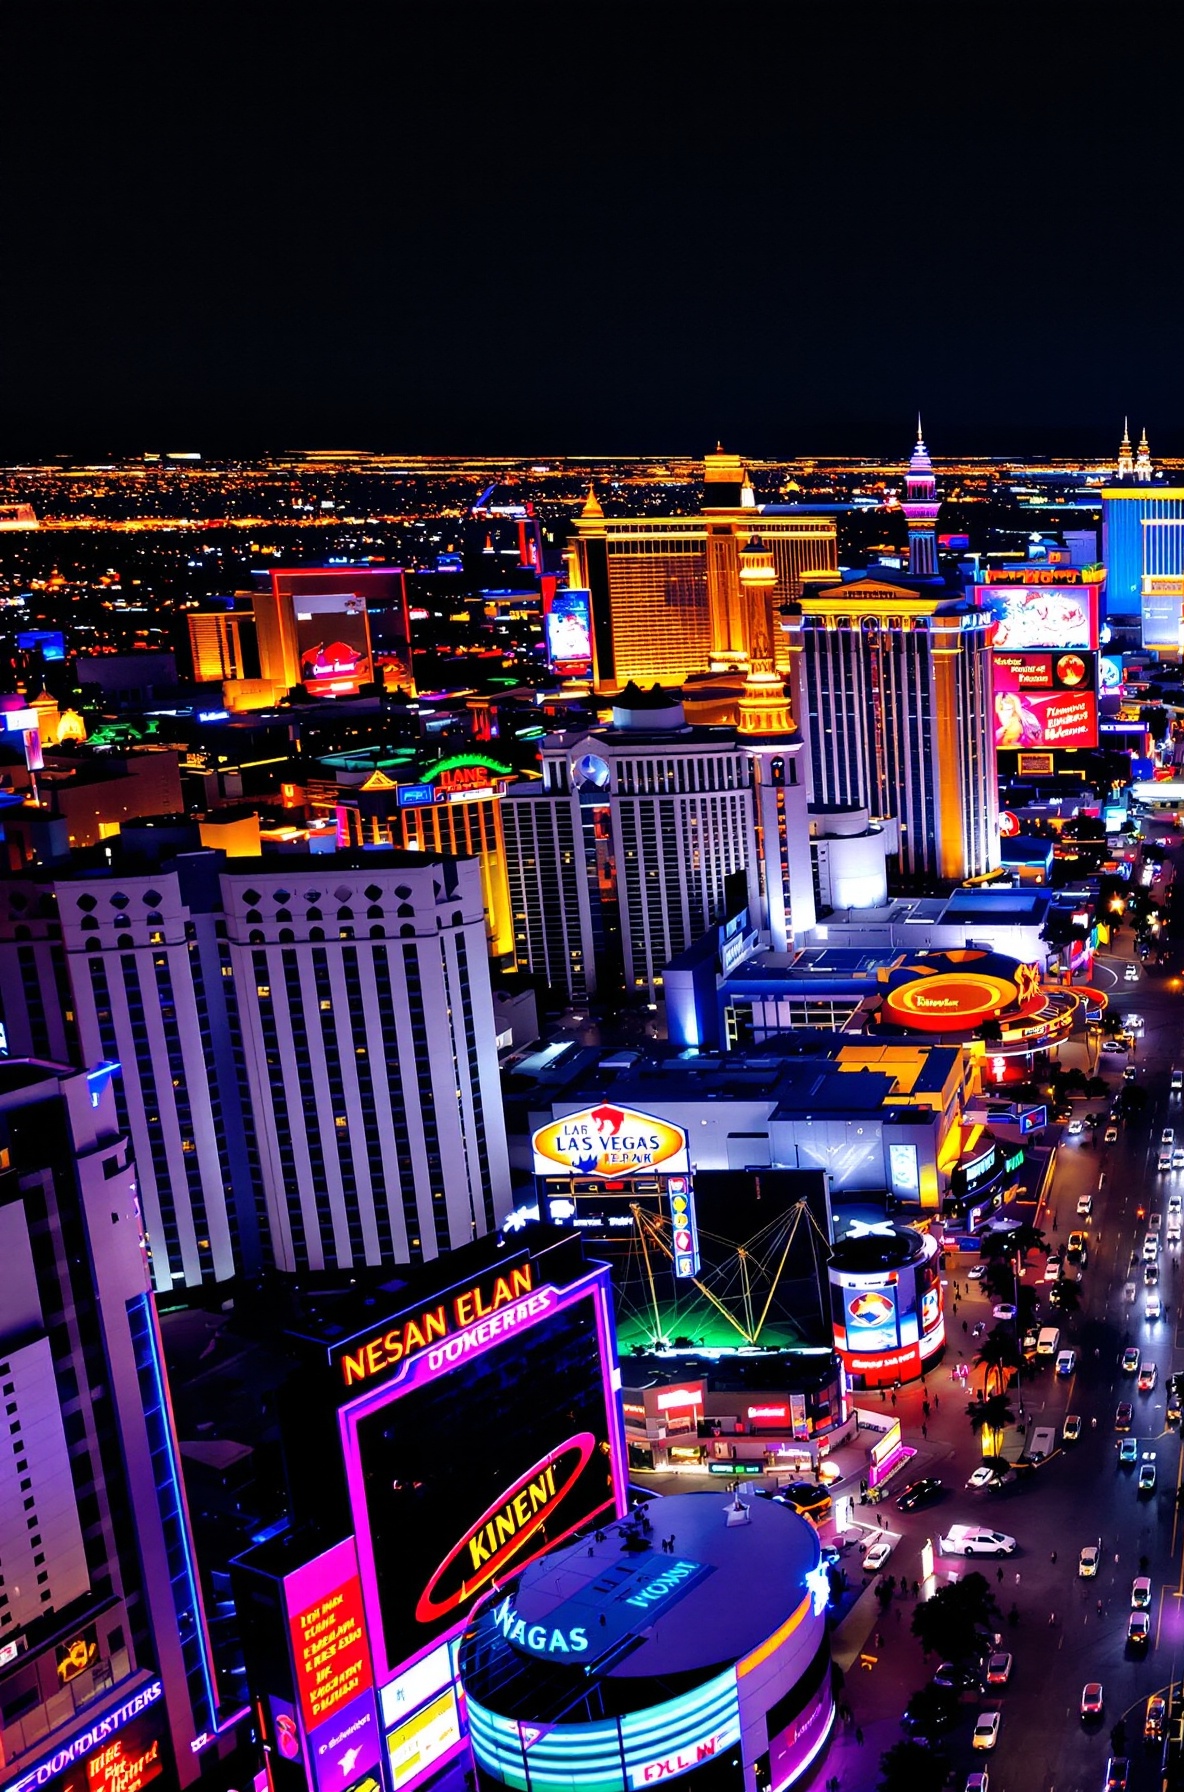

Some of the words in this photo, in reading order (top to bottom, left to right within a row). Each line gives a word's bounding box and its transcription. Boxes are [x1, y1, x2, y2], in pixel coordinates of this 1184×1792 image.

[556, 1136, 592, 1151] LAS
[599, 1136, 660, 1151] VEGAS
[342, 1304, 447, 1386] NESAN
[455, 1263, 532, 1328] ELAN
[469, 1465, 556, 1571] KINENI
